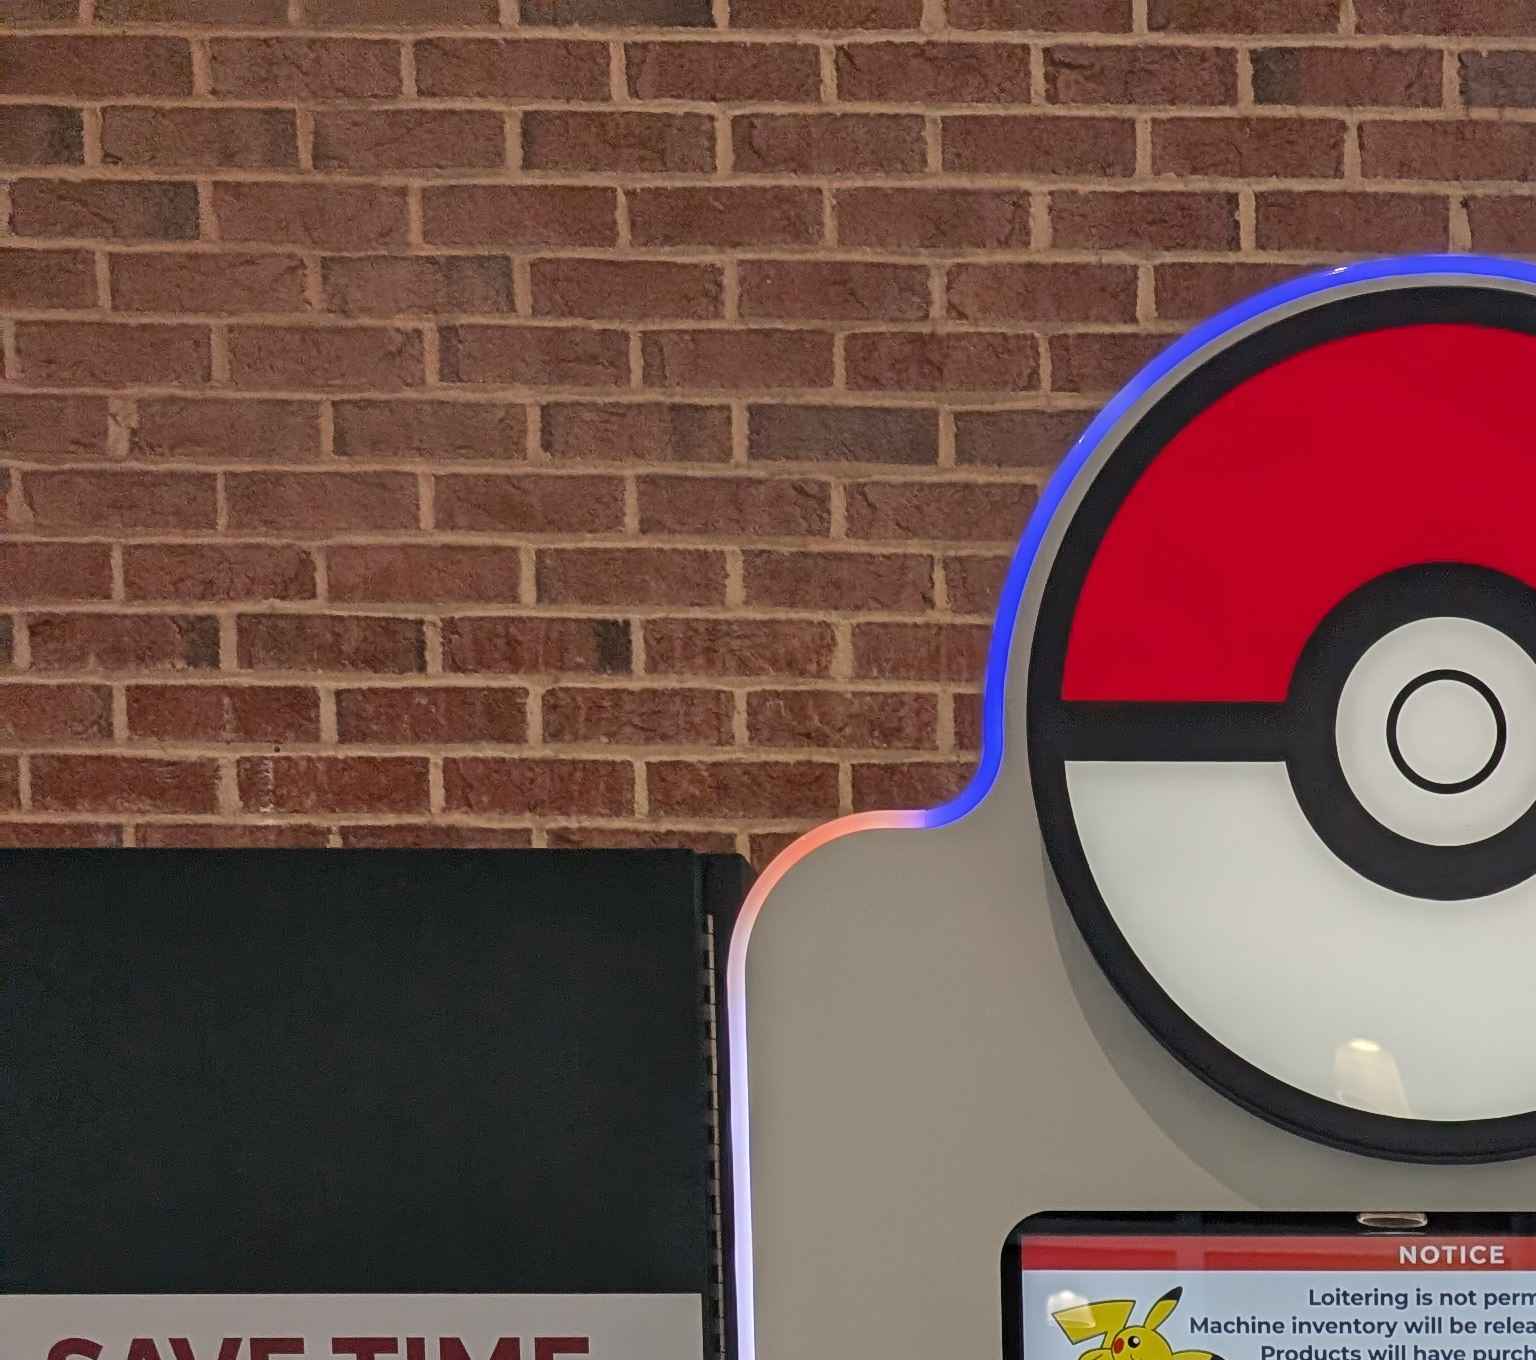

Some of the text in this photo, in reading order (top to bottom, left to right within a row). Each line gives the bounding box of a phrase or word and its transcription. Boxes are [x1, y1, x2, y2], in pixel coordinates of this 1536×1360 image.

[1399, 1244, 1505, 1265] NOTICE
[1309, 1287, 1409, 1311] Loitering
[1415, 1287, 1433, 1306] is
[1439, 1289, 1478, 1306] not
[1190, 1315, 1286, 1334] Machine
[1291, 1315, 1399, 1339] inventory
[1403, 1315, 1443, 1335] will
[1449, 1316, 1478, 1335] be
